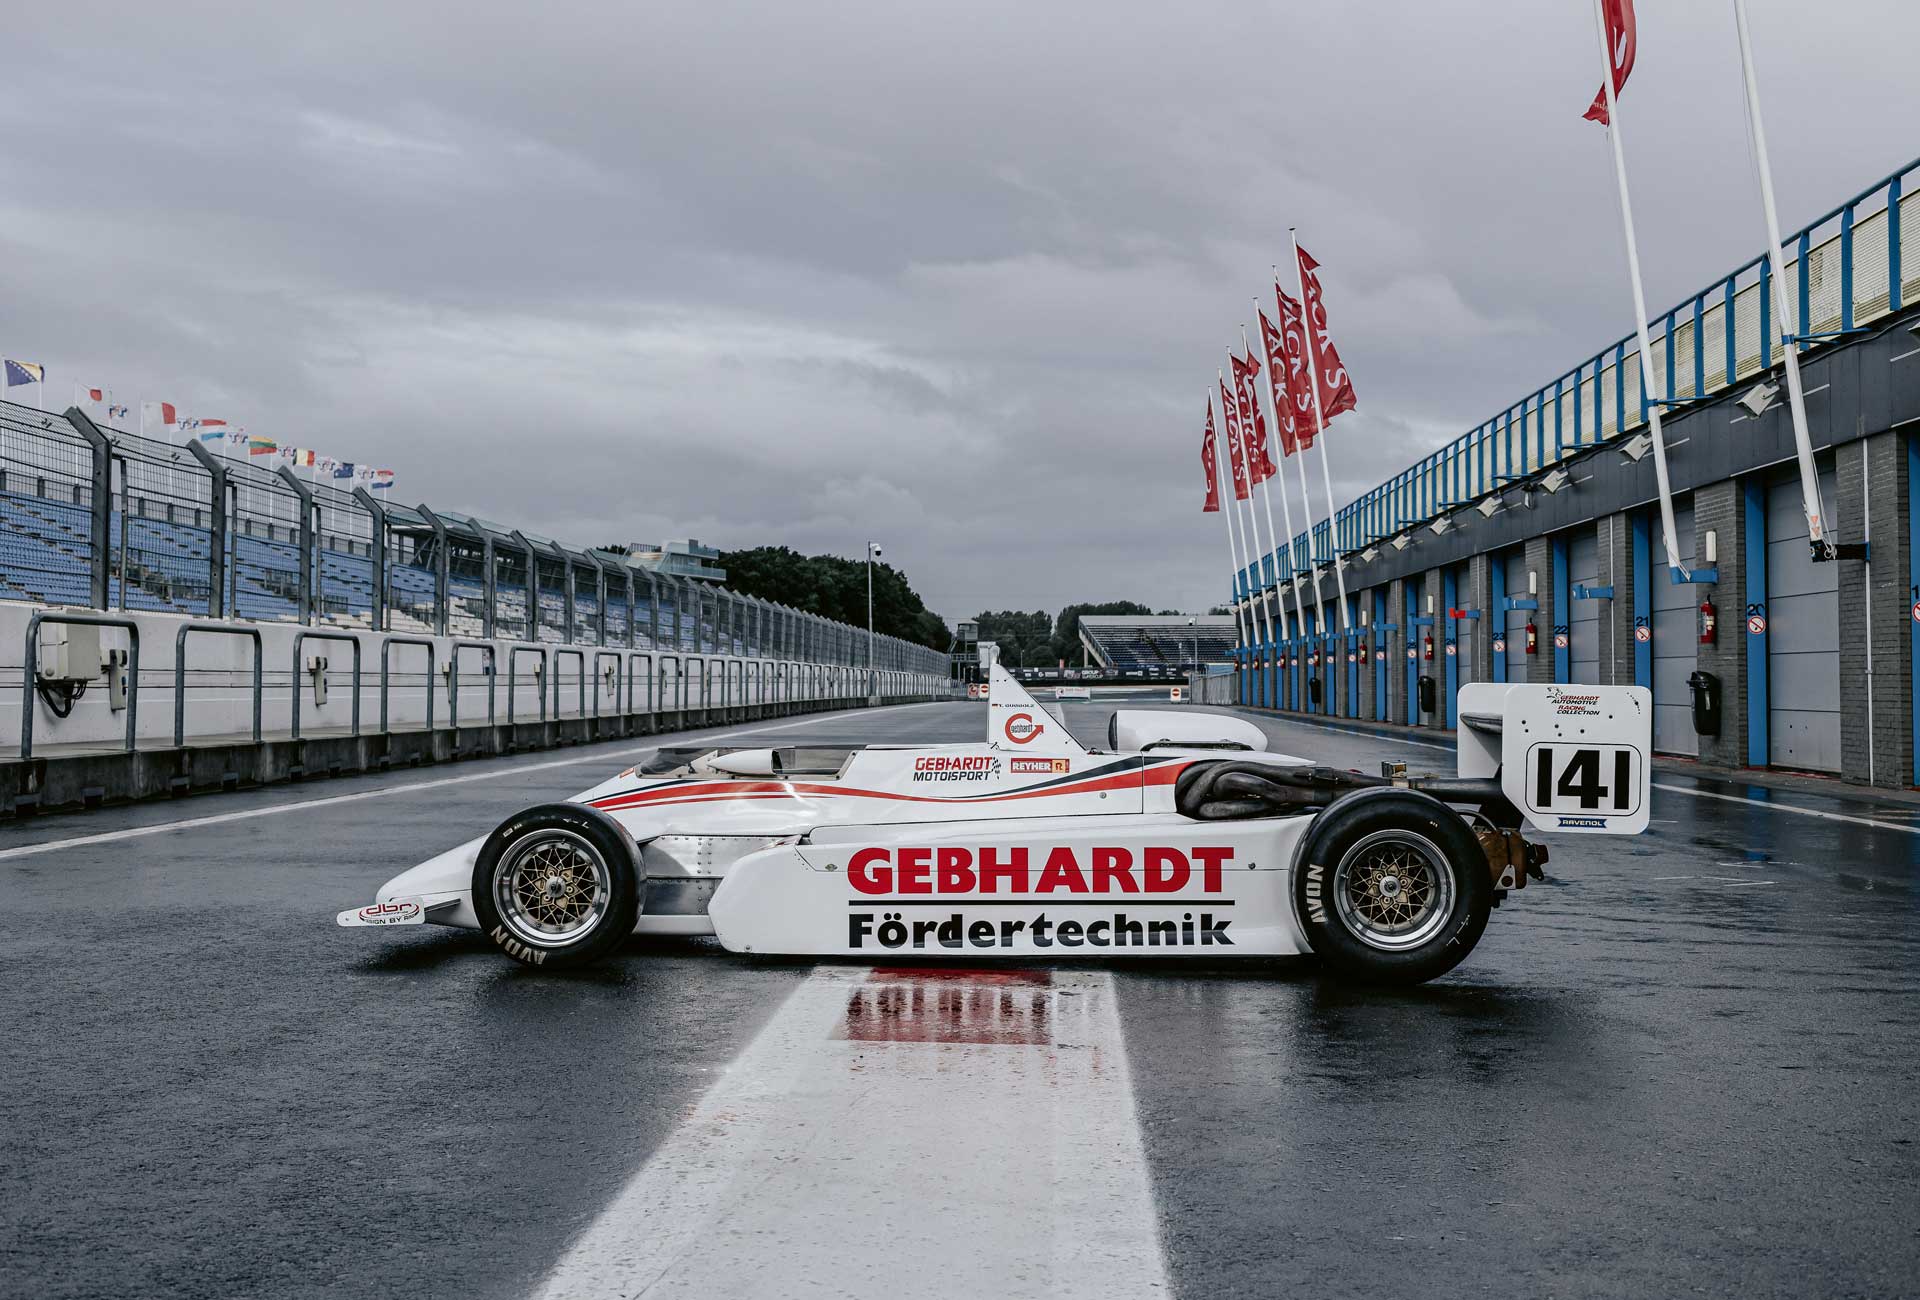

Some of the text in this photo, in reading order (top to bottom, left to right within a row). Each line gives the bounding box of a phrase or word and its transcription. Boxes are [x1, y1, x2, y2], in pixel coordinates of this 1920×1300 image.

[1635, 616, 1649, 627] 21
[1555, 625, 1568, 634] 22
[1011, 723, 1034, 734] gebhardt
[915, 756, 993, 771] GEBHARDT
[1012, 761, 1052, 771] REYHER
[1536, 748, 1630, 810] 141
[1562, 819, 1603, 827] RAVENOL
[847, 847, 1235, 895] GEBHARDT
[1306, 864, 1328, 923] AVON
[365, 903, 412, 915] dbr
[848, 912, 1236, 948] Fördertechnik
[491, 925, 547, 965] AVON
